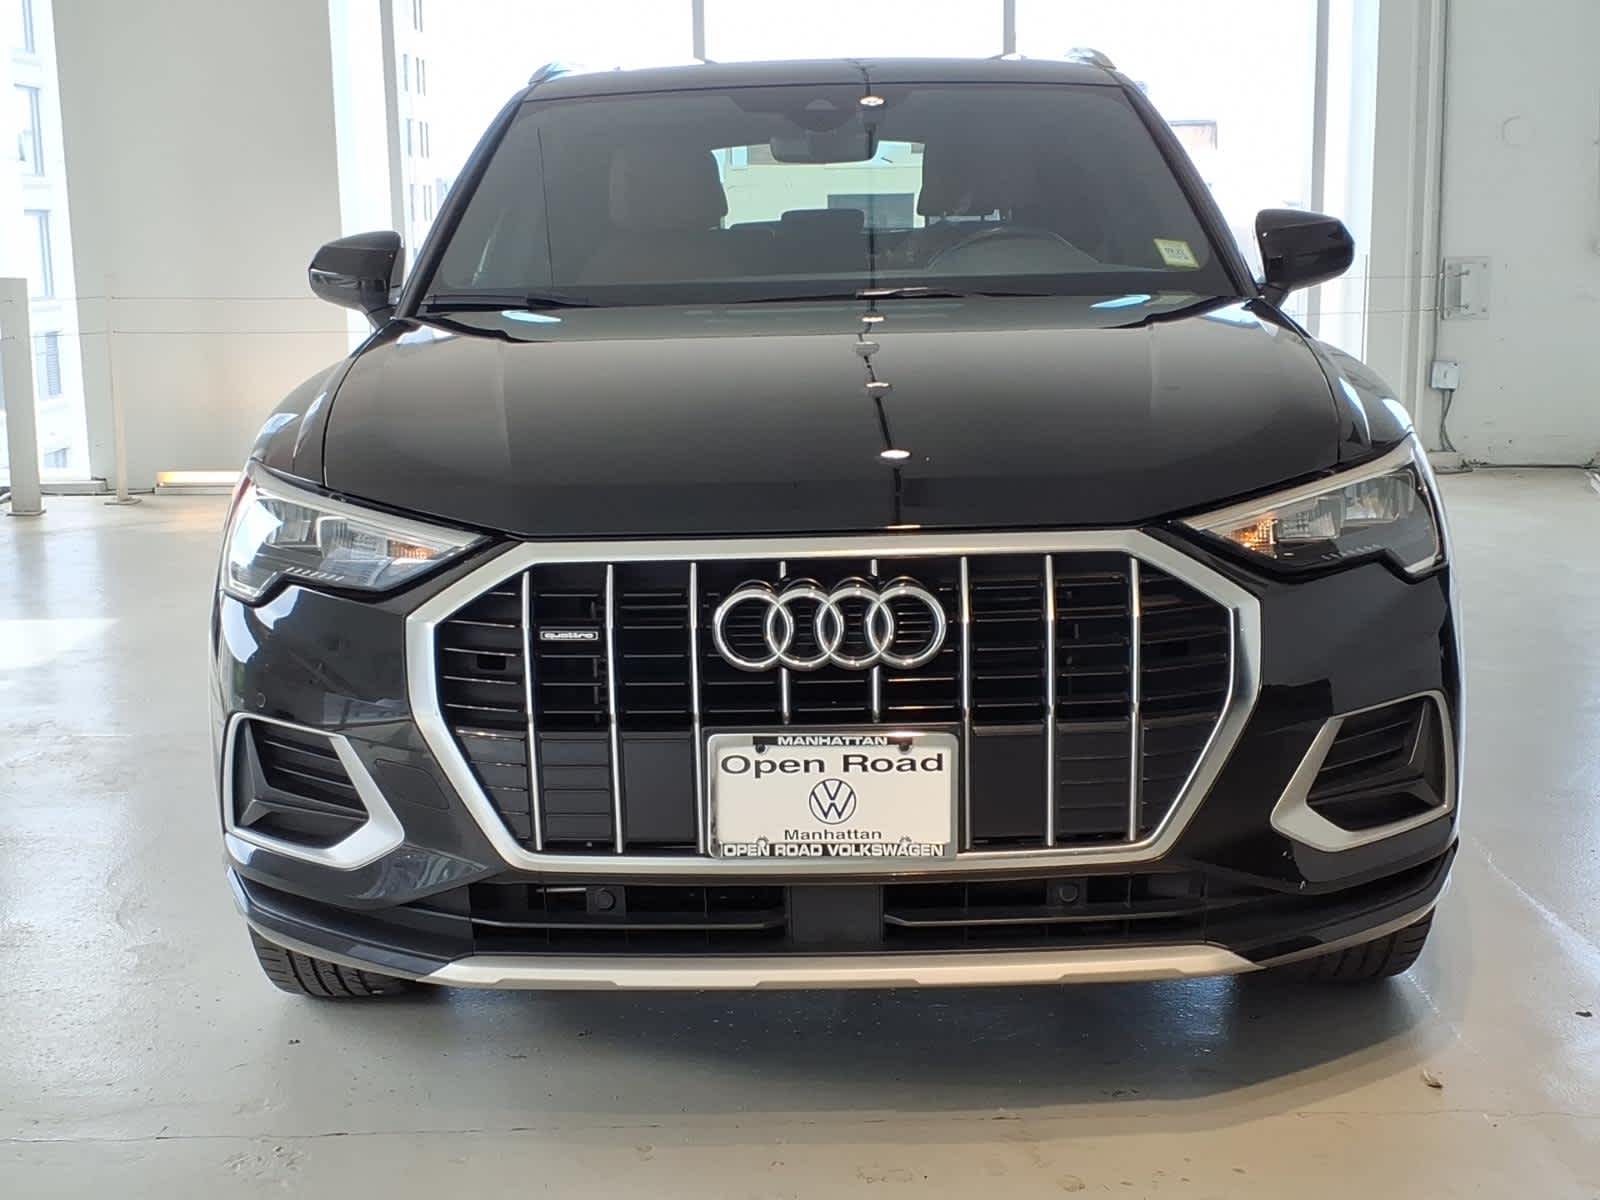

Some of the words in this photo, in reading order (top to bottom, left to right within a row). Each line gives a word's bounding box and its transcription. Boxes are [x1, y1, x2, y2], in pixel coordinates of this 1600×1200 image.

[777, 736, 888, 746] MANHATTAN
[721, 755, 825, 778] Open
[843, 753, 943, 772] Road
[809, 778, 857, 825] VW
[784, 829, 882, 841] Manhattan
[723, 844, 770, 857] OPEN
[774, 844, 823, 857] ROAD
[827, 844, 944, 857] VOLKSWAGEN
